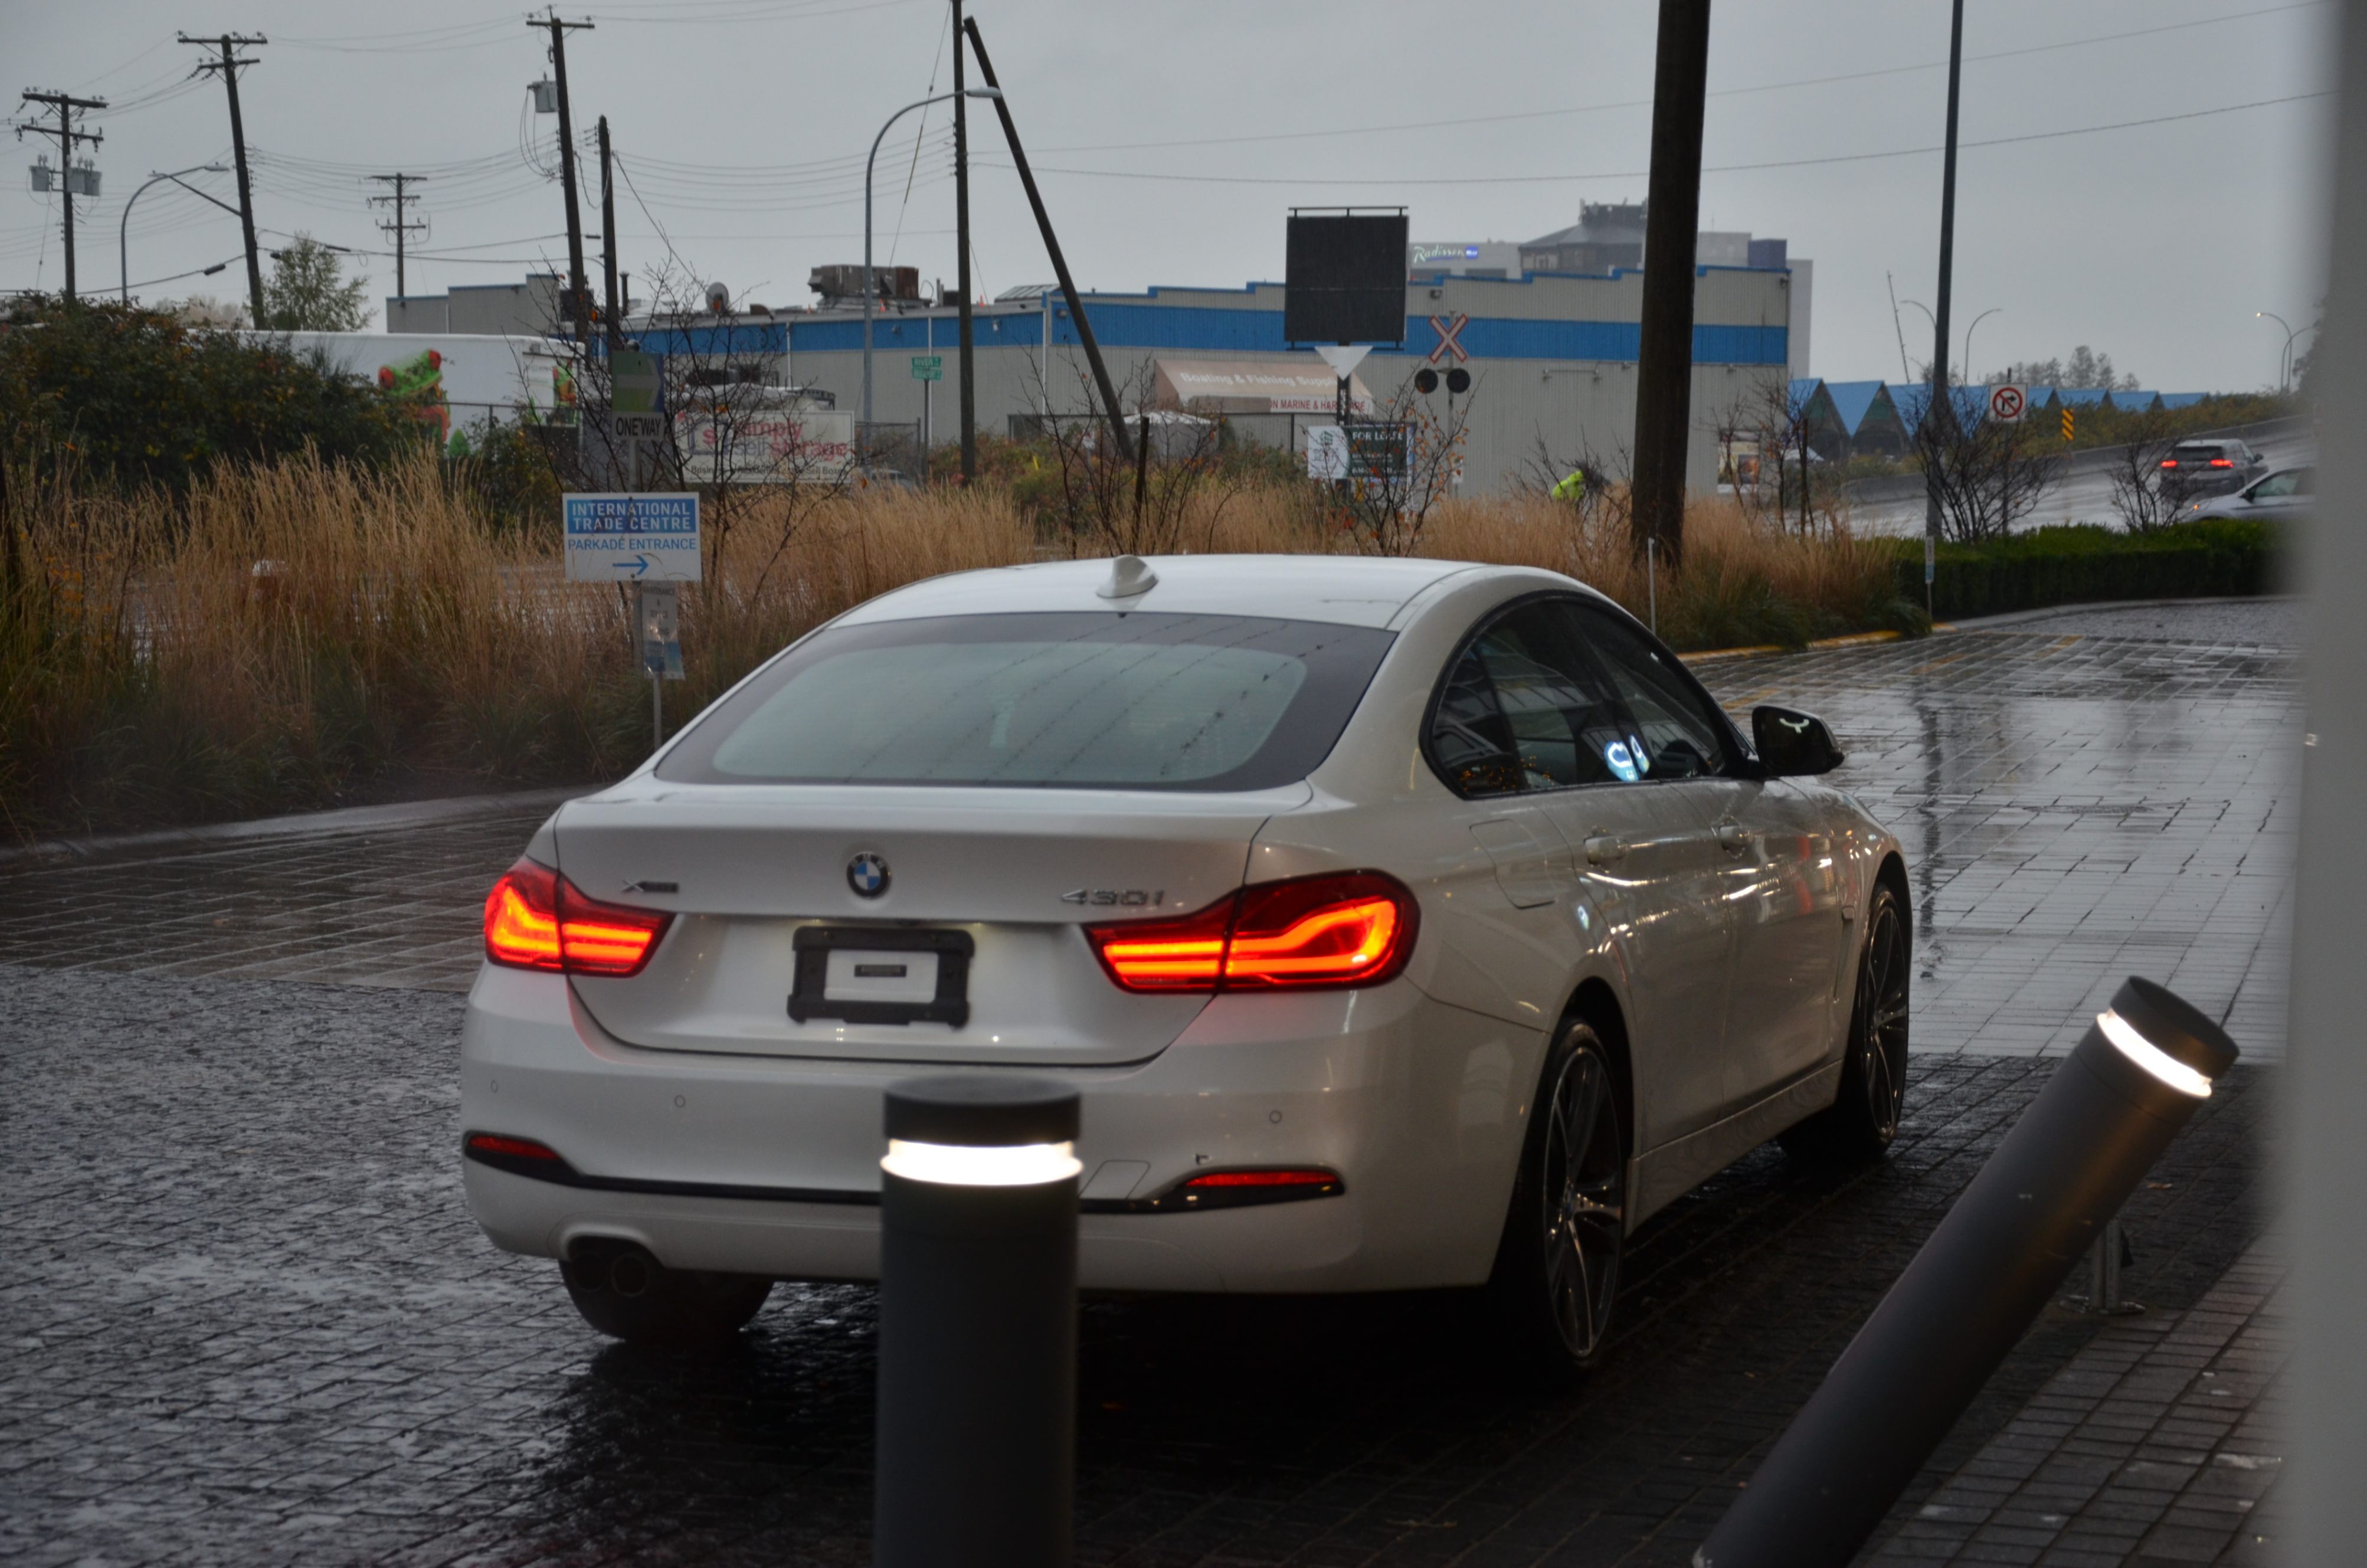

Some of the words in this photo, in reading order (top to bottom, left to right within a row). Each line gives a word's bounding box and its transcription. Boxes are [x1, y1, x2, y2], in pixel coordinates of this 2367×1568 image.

[1413, 244, 1464, 263] Radisson
[914, 358, 933, 366] RIVER
[1180, 373, 1233, 385] Boating
[1235, 374, 1245, 384] &
[1246, 374, 1297, 387] Fishing
[1297, 375, 1337, 387] Suppli
[1281, 400, 1311, 410] MARINE
[1313, 400, 1319, 410] &
[1321, 400, 1365, 411] HARARE
[616, 417, 639, 436] ONE
[641, 417, 661, 436] WAY
[1353, 431, 1371, 440] FOR
[572, 502, 690, 516] INTERNATIONAL
[574, 517, 624, 531] TRADE
[630, 517, 690, 530] CENTRE
[568, 539, 626, 550] PARKADE
[629, 538, 696, 550] ENTRANCE
